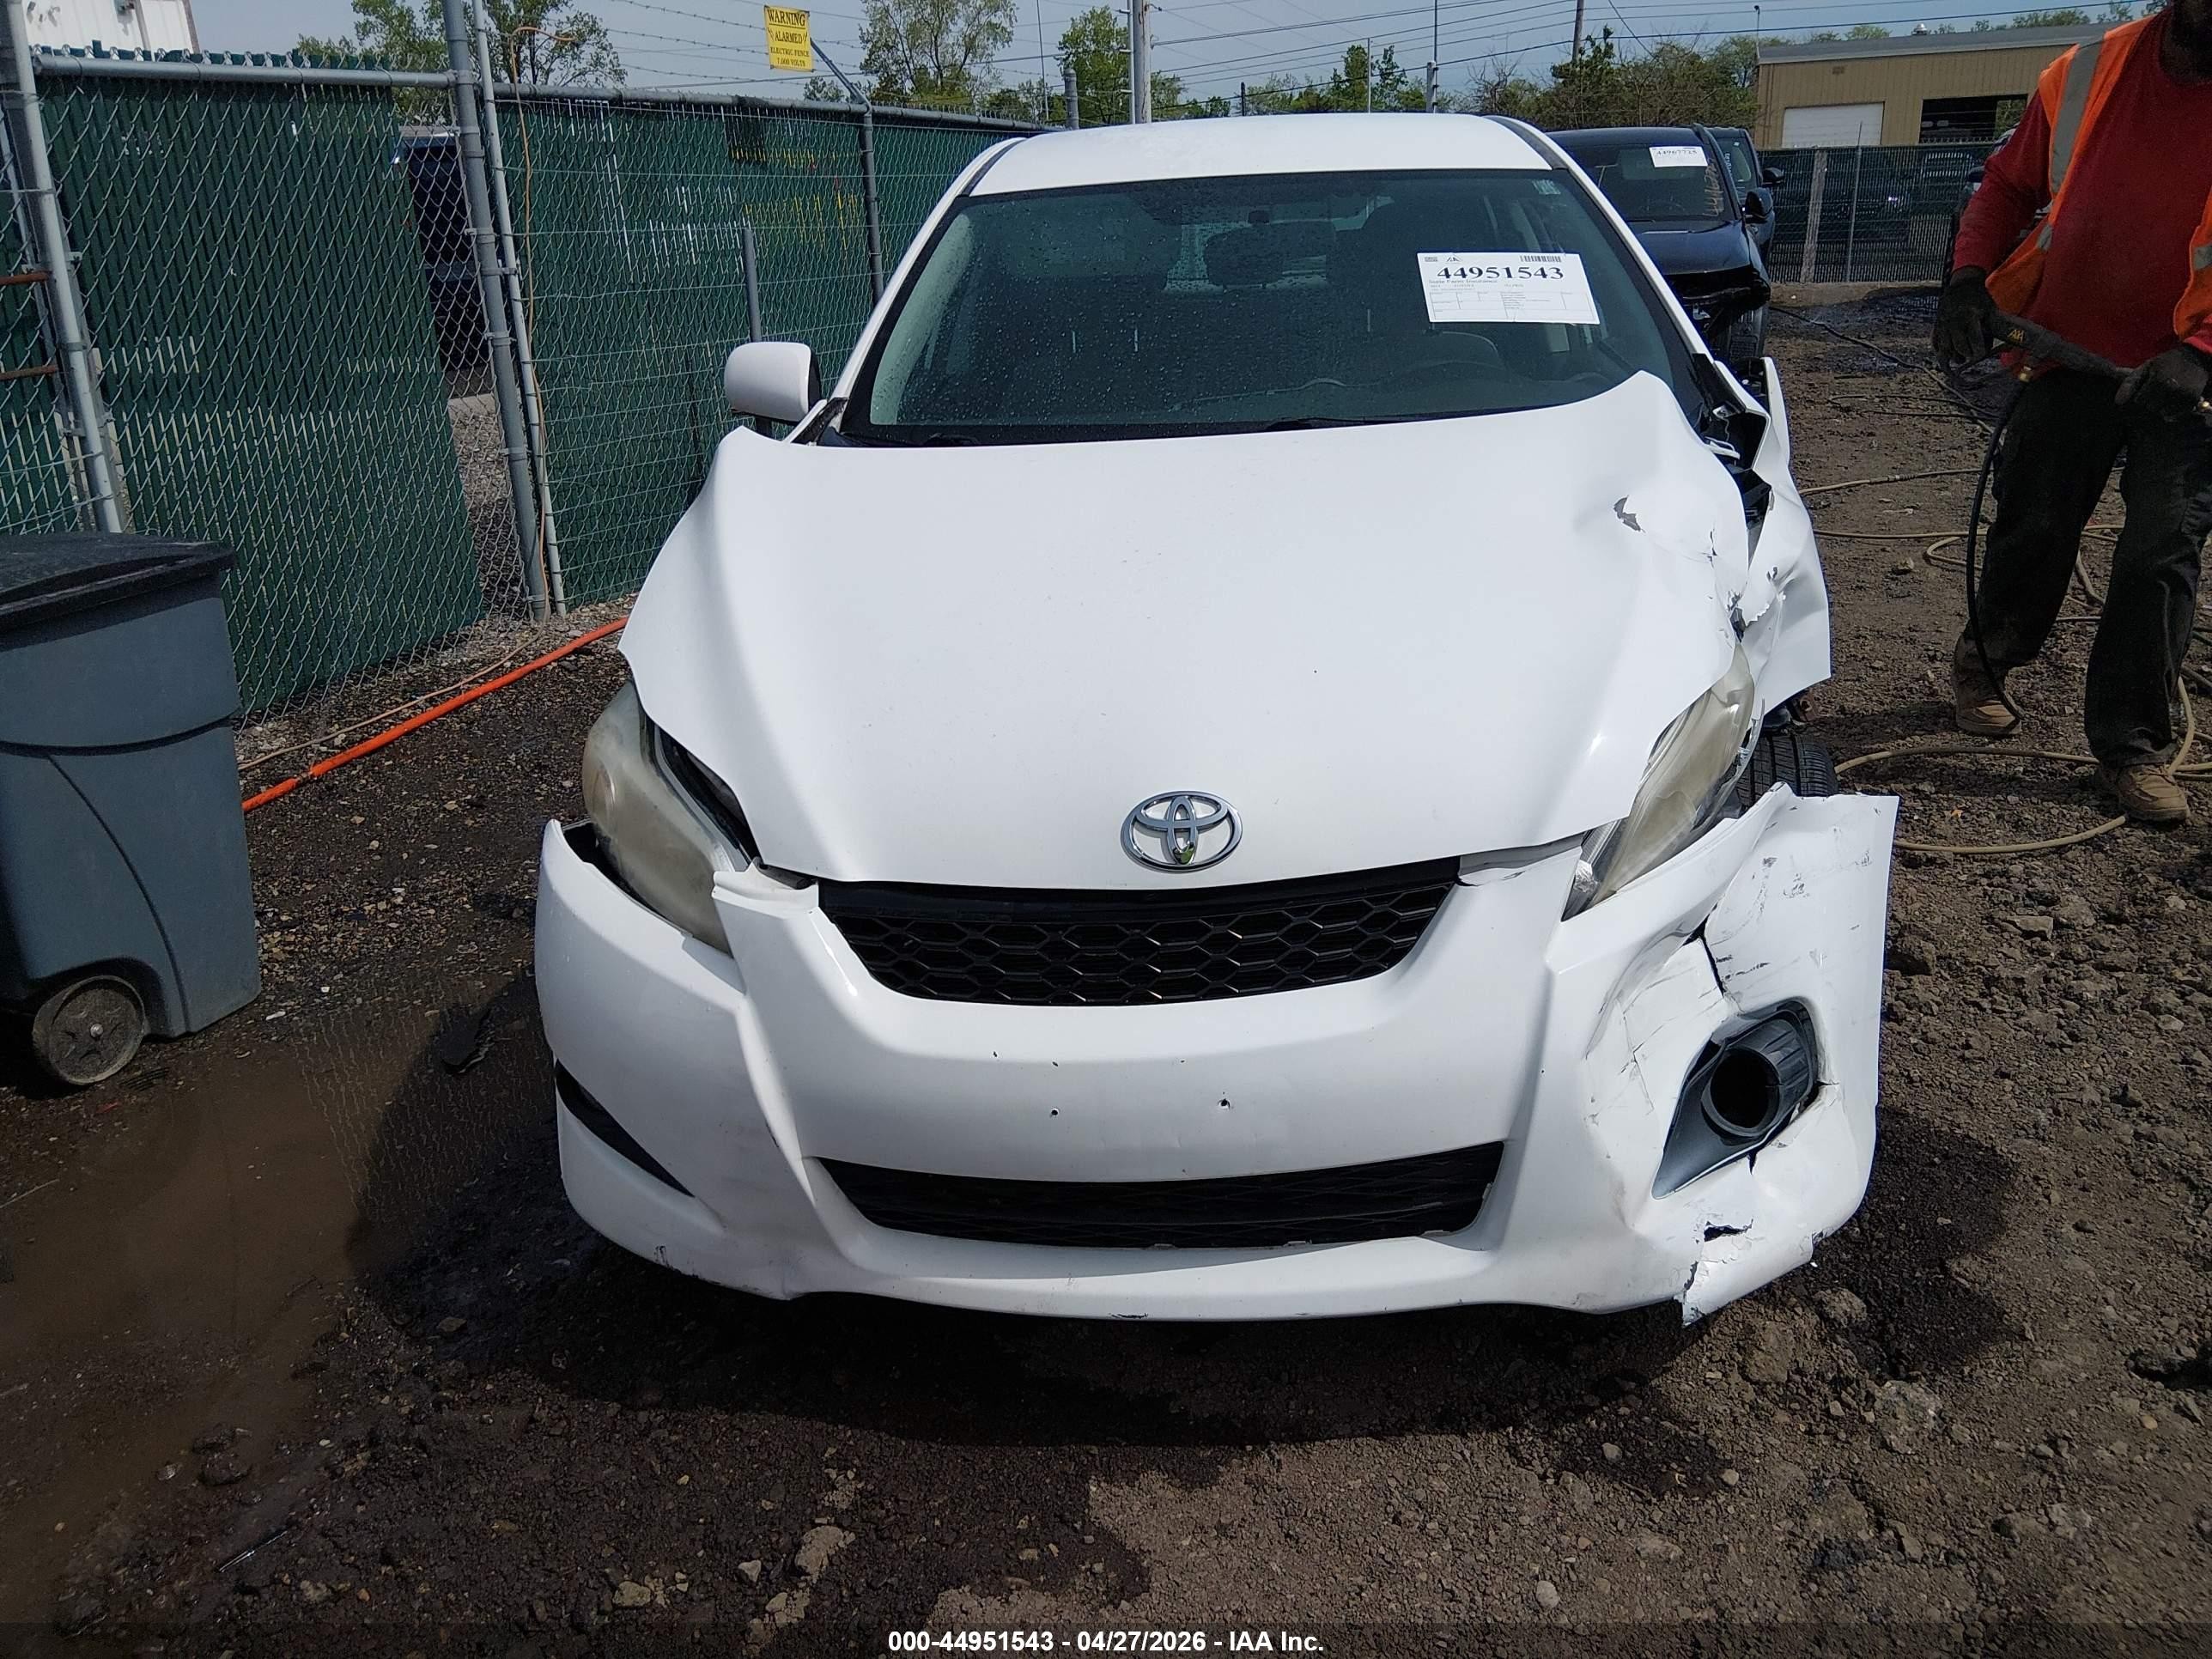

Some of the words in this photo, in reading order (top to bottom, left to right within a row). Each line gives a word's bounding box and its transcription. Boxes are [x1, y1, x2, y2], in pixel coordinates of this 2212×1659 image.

[767, 9, 805, 27] WARNING
[775, 31, 803, 44] ALARMED
[770, 46, 793, 55] ELECTRIC
[793, 49, 810, 58] FENCE
[1437, 266, 1564, 280] 44951543
